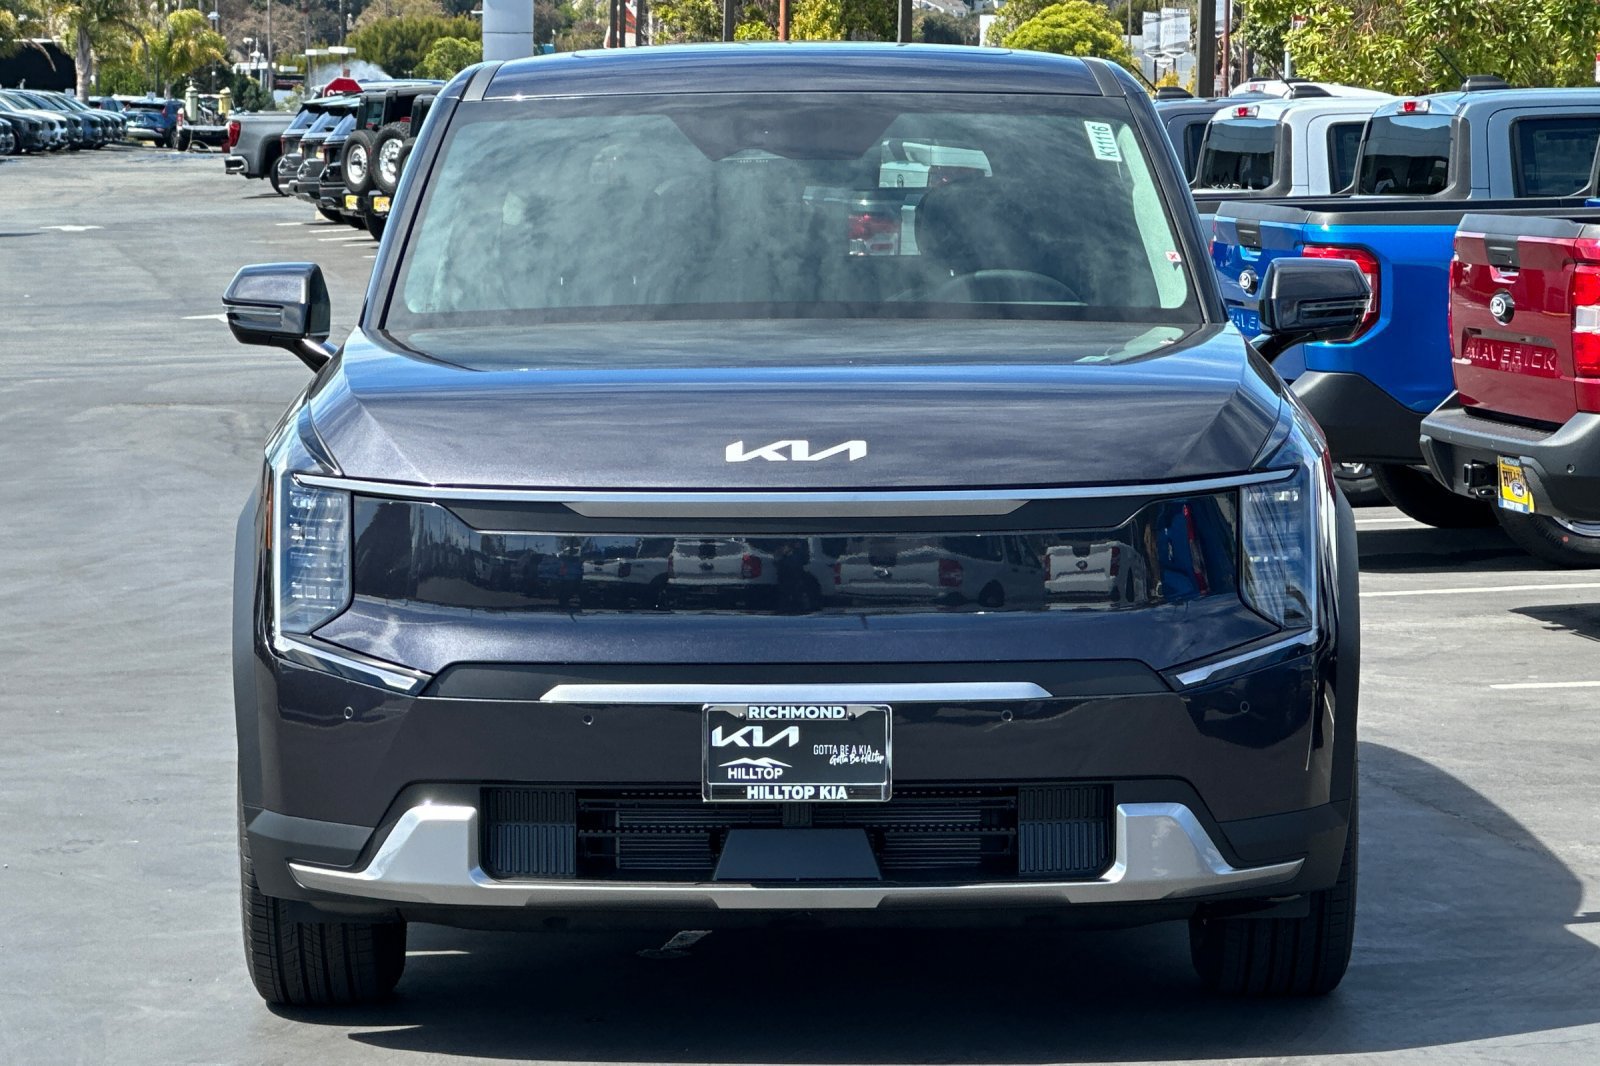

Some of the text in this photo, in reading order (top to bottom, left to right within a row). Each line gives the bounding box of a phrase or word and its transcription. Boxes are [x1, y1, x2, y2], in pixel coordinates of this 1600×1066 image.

[1464, 338, 1555, 371] MAVERICK
[725, 440, 867, 462] KIA
[748, 706, 845, 719] RICHMOND
[711, 725, 800, 748] KIA
[813, 744, 871, 755] GOTTA BE A KIA
[727, 767, 783, 780] HILLTOP
[746, 785, 848, 800] HILLTOP KIA
